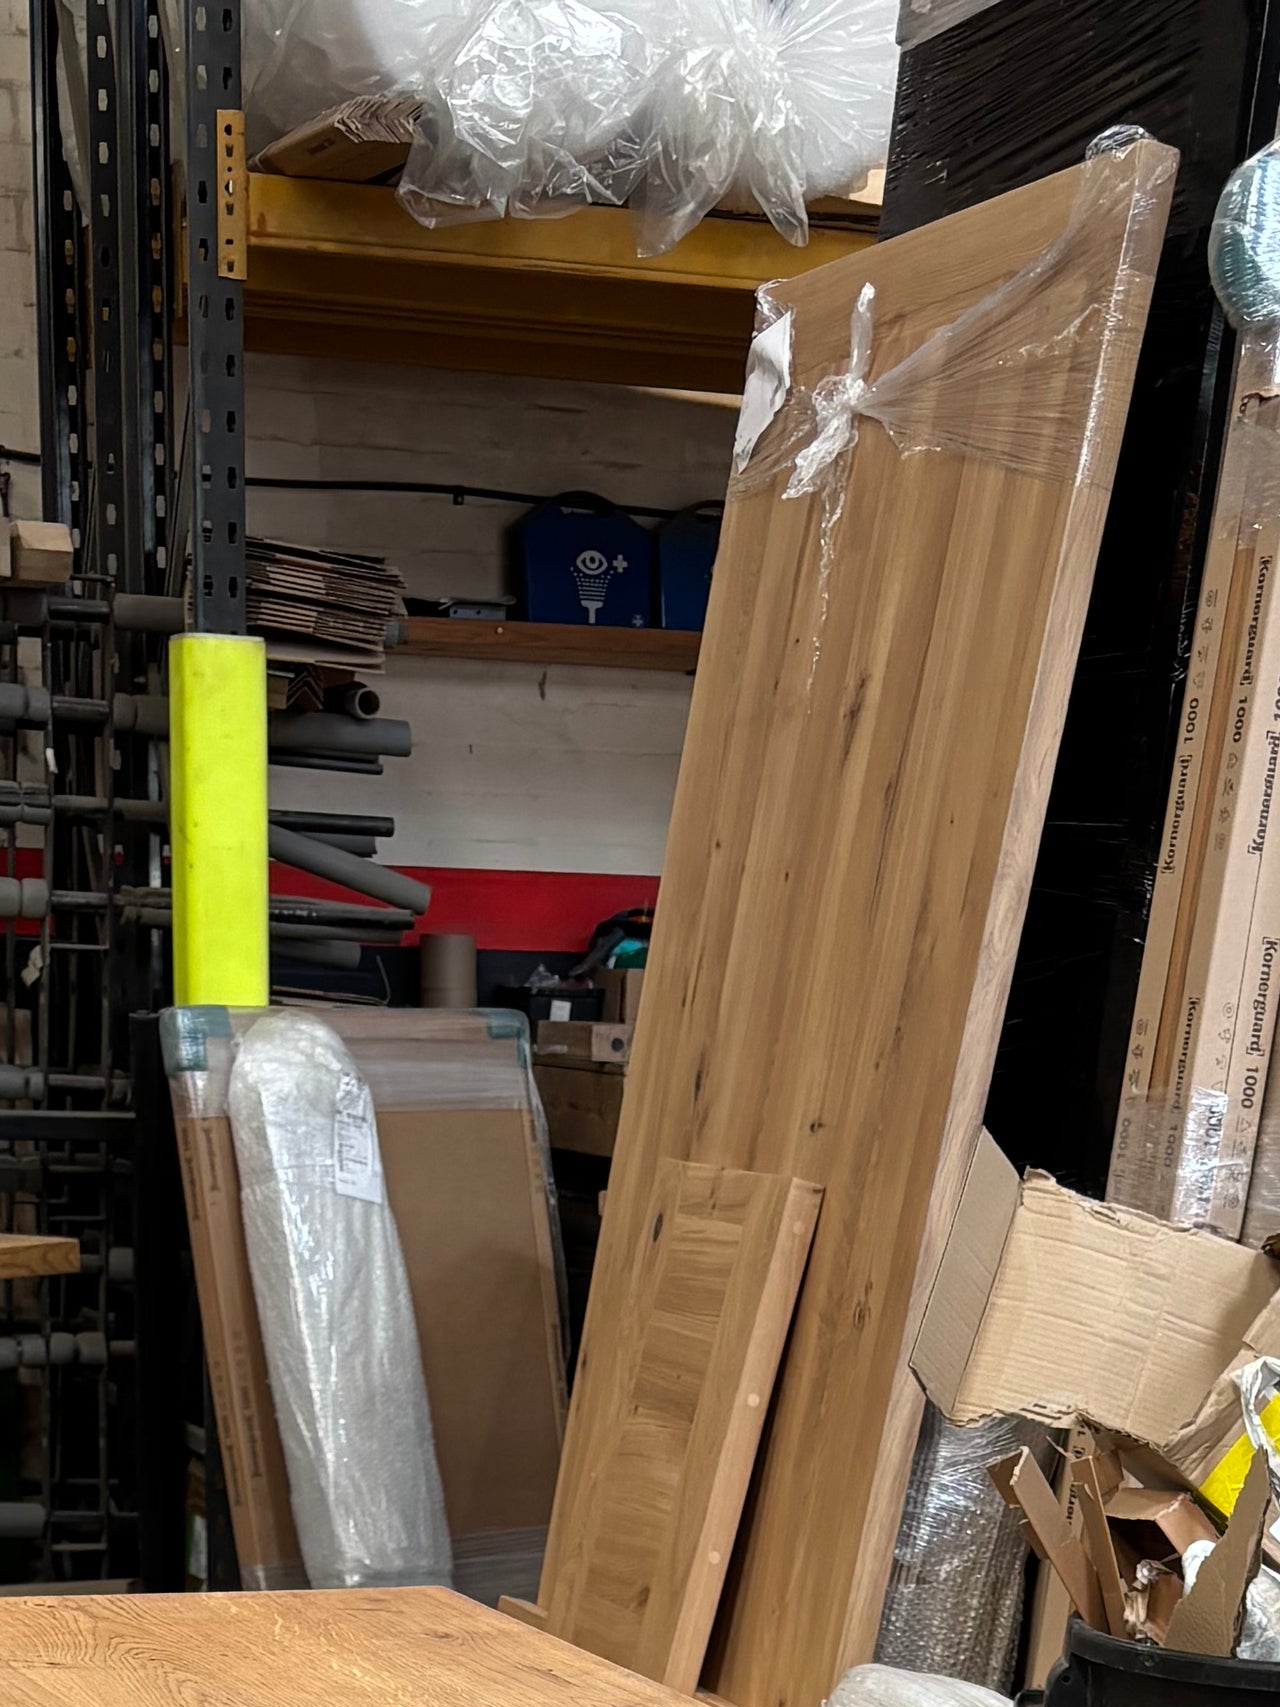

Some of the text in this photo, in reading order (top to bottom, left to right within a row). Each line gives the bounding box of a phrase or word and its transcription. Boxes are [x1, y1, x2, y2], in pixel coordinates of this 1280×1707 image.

[1184, 697, 1200, 745] 1000
[1232, 696, 1248, 743] 1000
[1240, 1066, 1260, 1110] 1000
